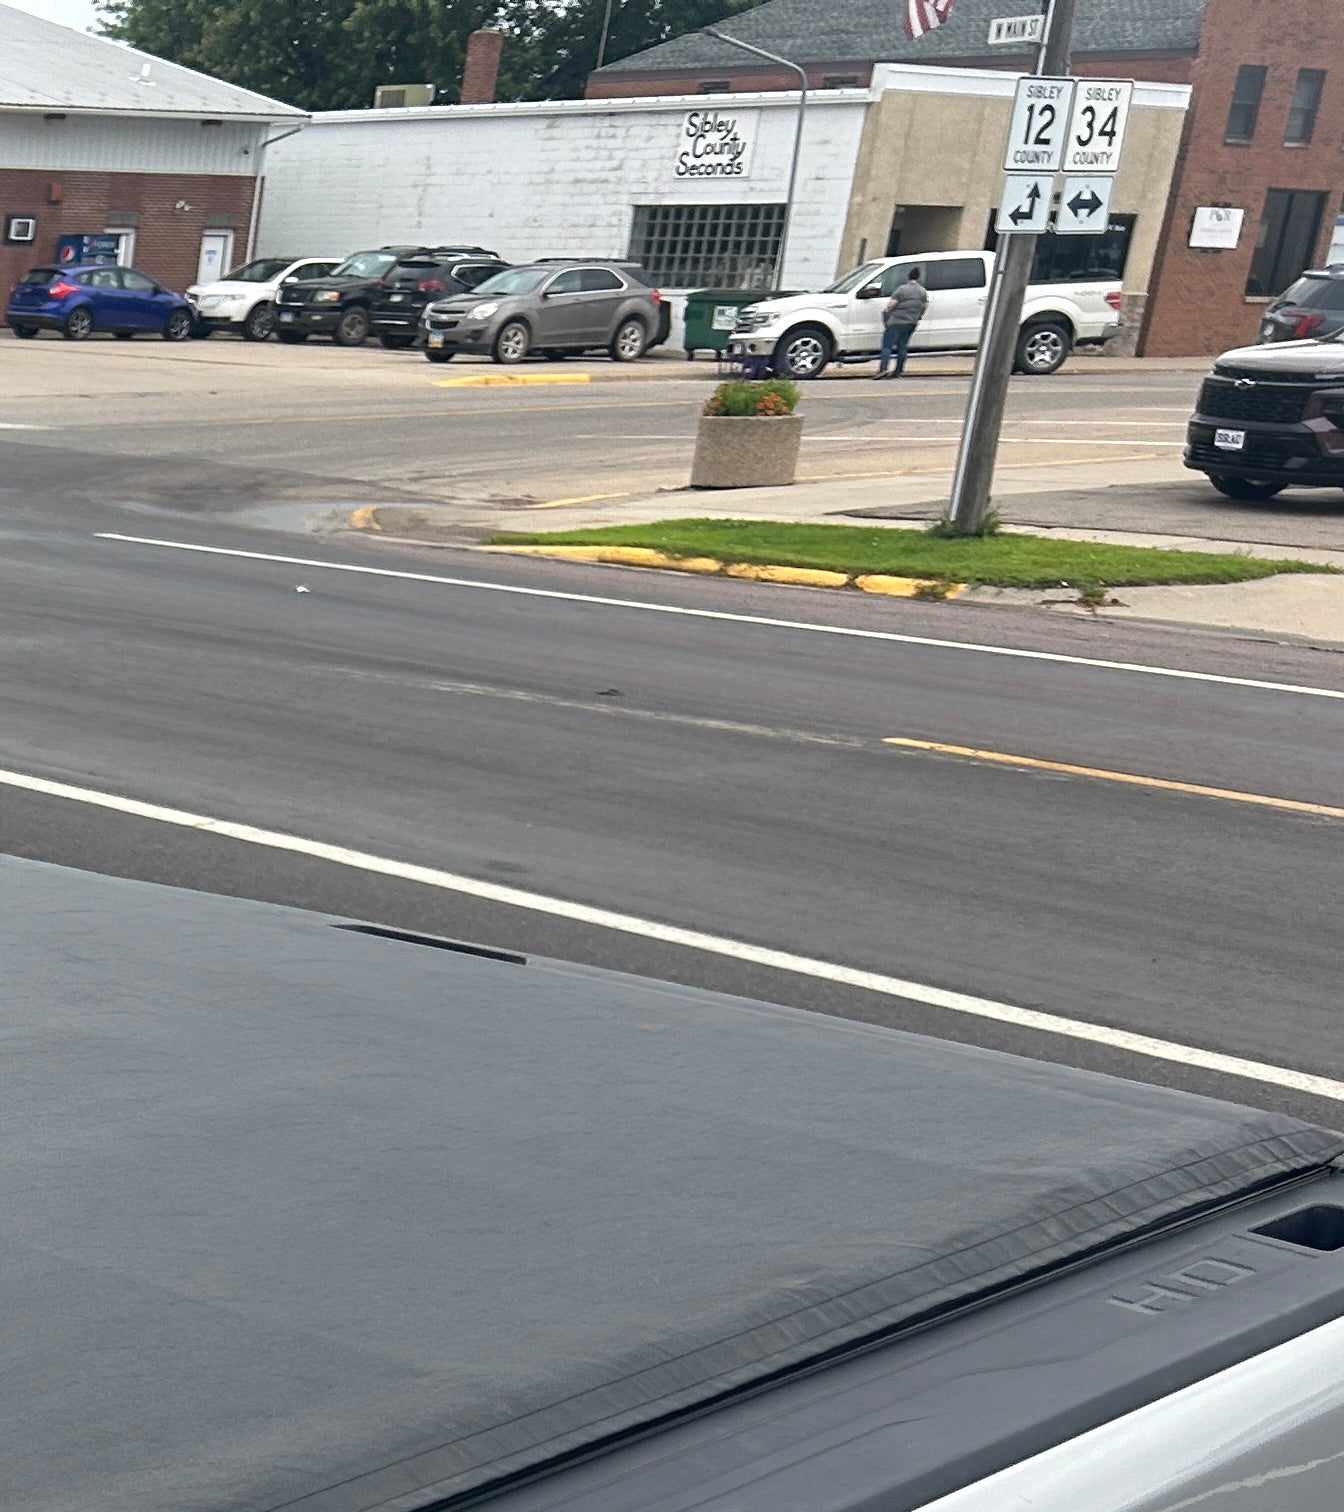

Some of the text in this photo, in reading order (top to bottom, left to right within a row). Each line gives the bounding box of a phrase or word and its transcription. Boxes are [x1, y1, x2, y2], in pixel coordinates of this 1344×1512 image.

[1005, 20, 1027, 39] MAIN
[1026, 85, 1064, 99] SIBLEY
[1085, 87, 1121, 101] SIBLEY
[686, 112, 736, 141] Sibley
[1024, 103, 1056, 145] 12
[1076, 105, 1118, 147] 34
[692, 132, 747, 162] County
[1013, 150, 1054, 164] COUNTY
[1072, 151, 1113, 165] COUNTY
[675, 151, 743, 176] Seconds
